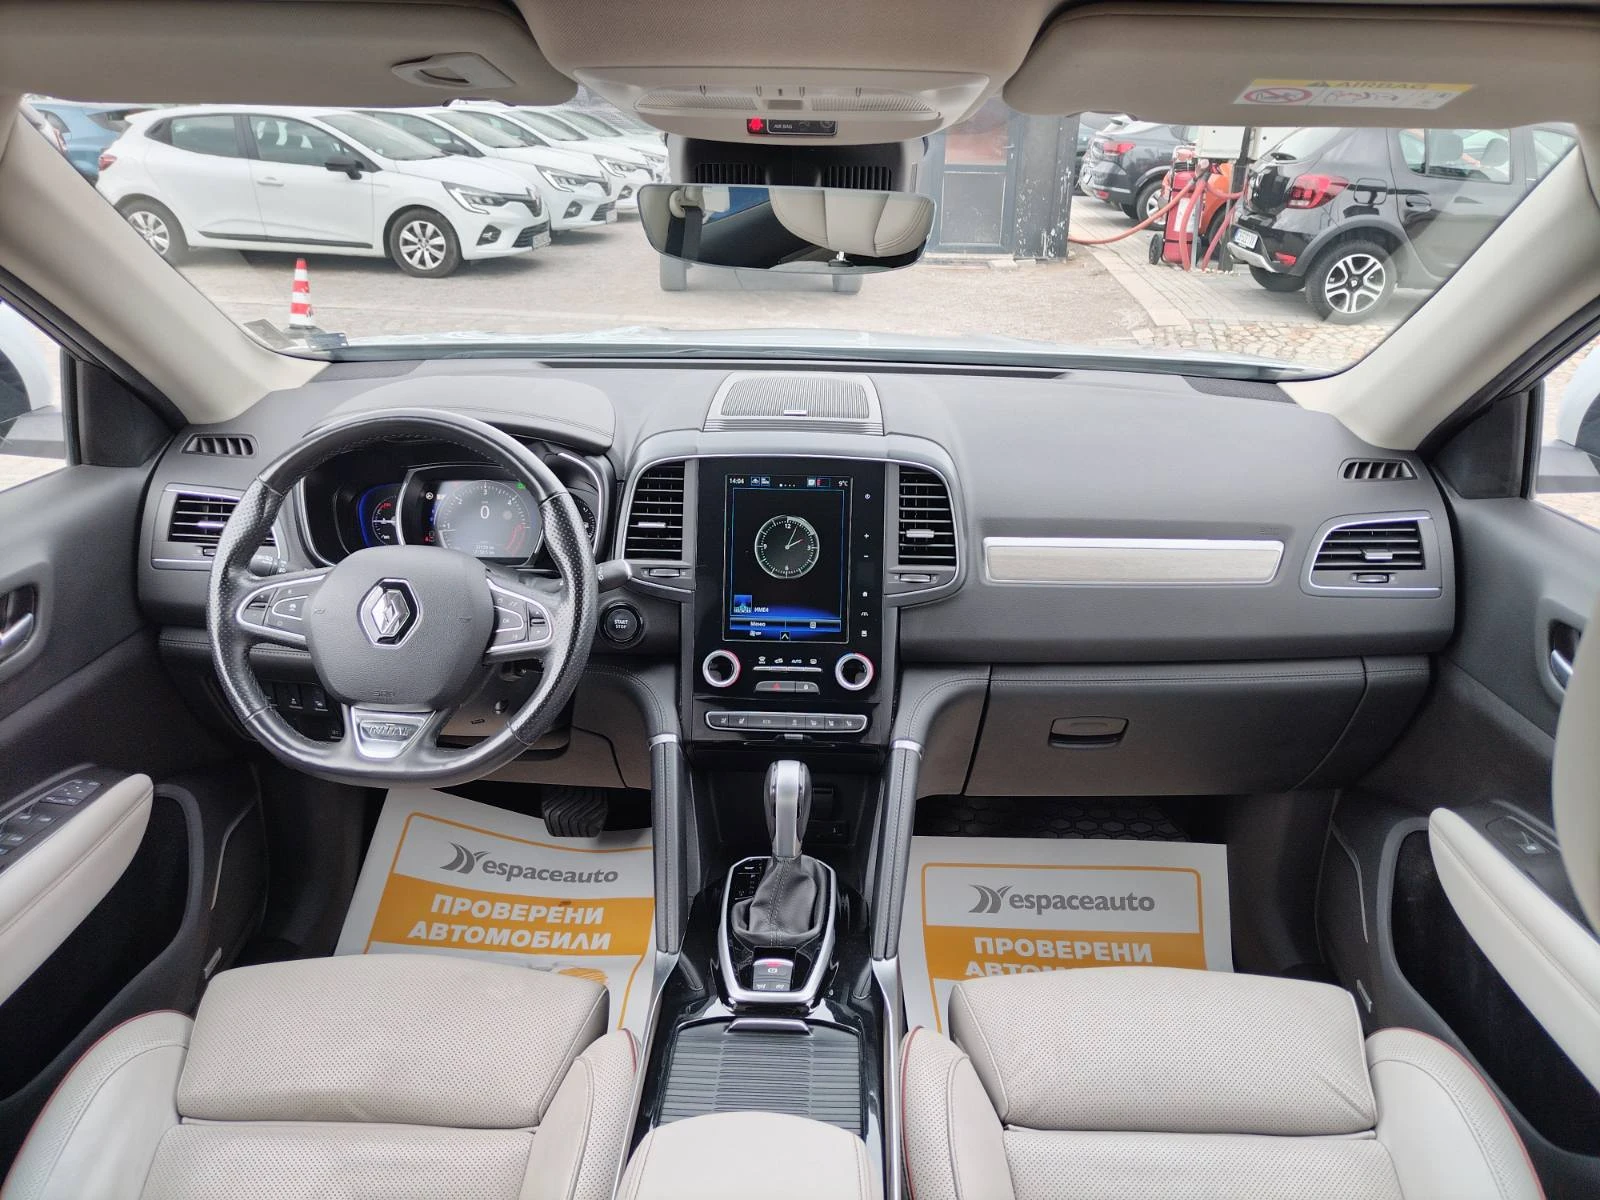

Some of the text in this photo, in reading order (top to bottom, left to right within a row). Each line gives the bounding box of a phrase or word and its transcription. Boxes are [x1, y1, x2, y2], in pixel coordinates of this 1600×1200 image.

[480, 505, 490, 519] 0
[482, 858, 619, 883] espaceauto
[430, 893, 605, 925] ПРОВЕРЕНИ
[1009, 891, 1156, 915] espaceauto
[407, 920, 612, 951] АВТОМОБИЛИ
[973, 936, 1154, 963] ПРОВЕРЕНИ
